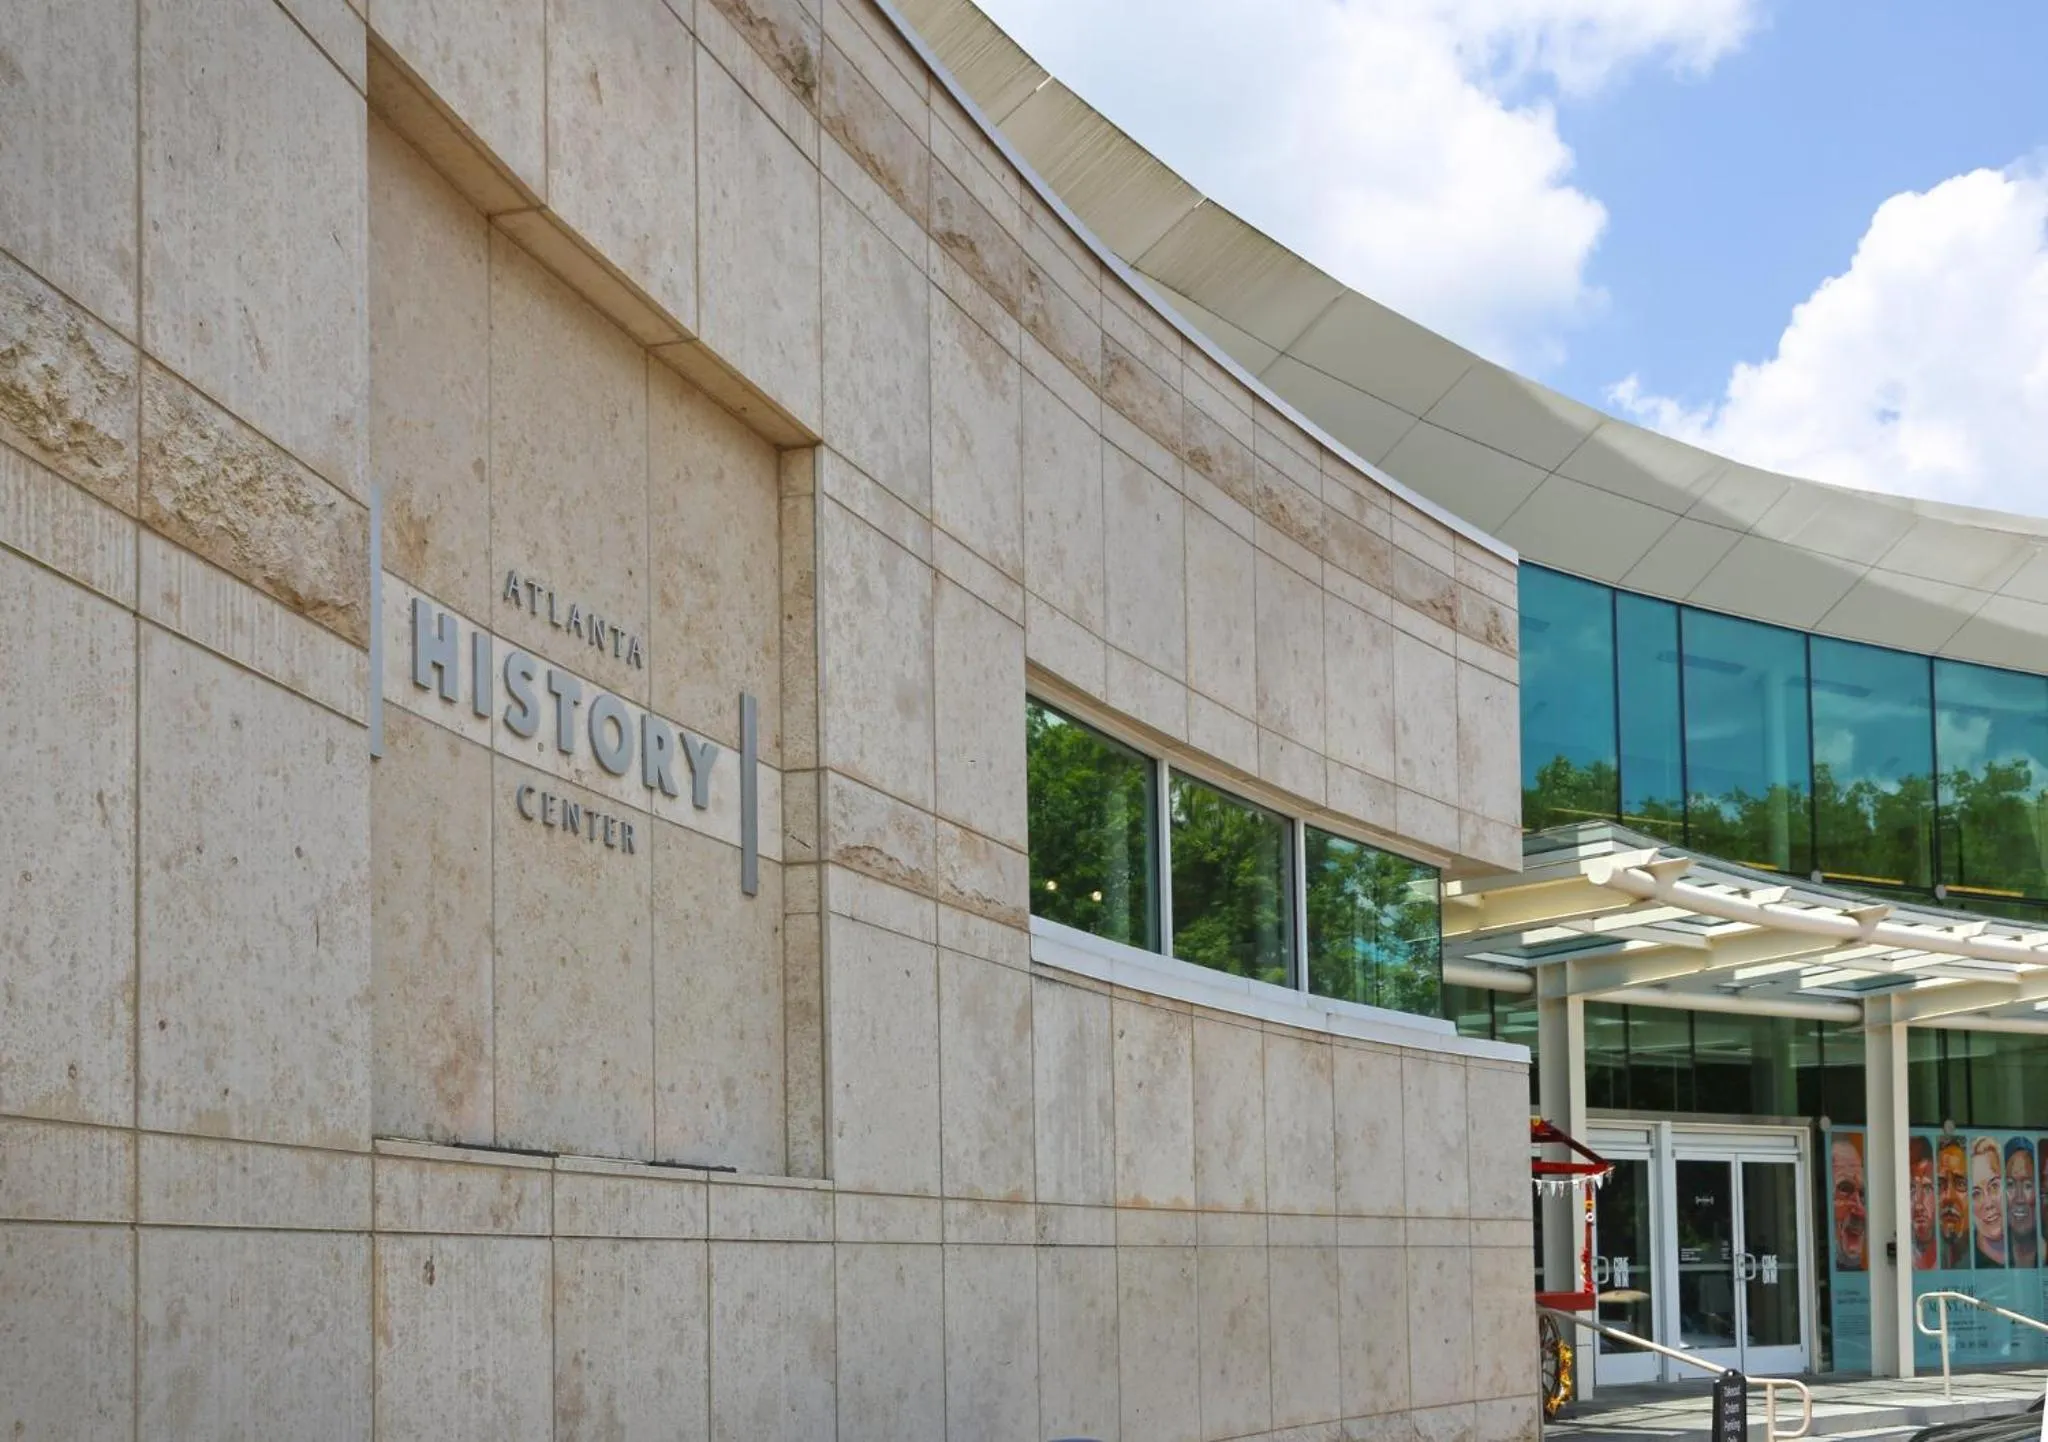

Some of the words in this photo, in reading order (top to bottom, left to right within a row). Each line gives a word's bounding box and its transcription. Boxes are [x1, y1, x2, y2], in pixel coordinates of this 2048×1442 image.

[503, 569, 644, 669] ATLANTA
[412, 597, 720, 810] HISTORY
[516, 783, 635, 854] CENTER
